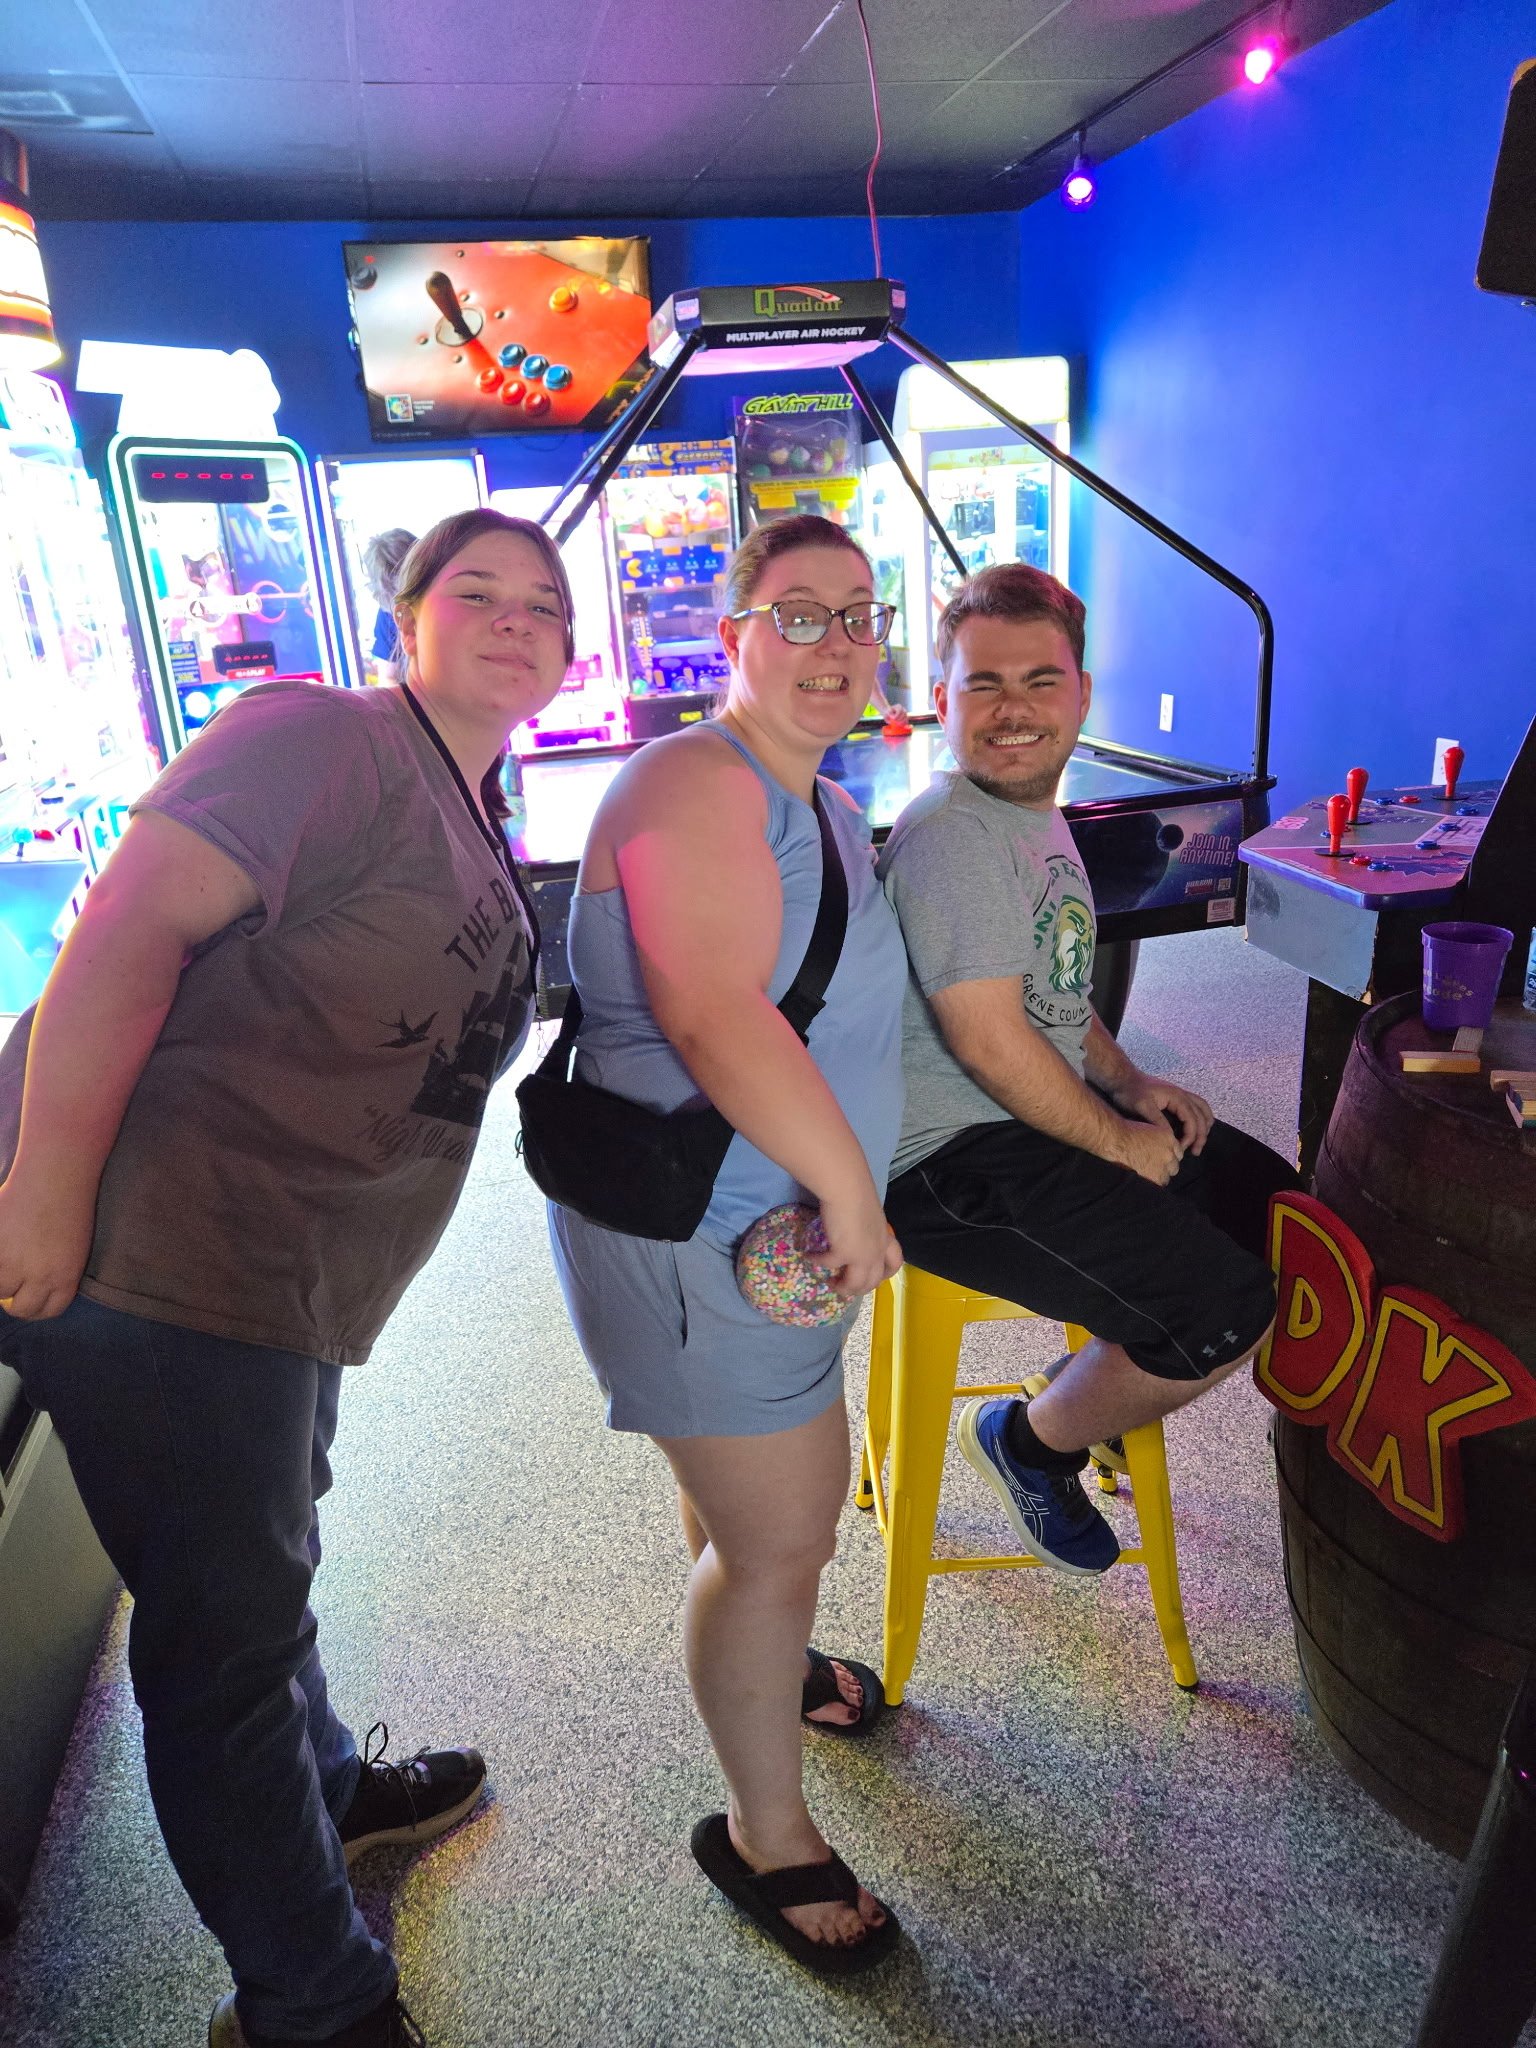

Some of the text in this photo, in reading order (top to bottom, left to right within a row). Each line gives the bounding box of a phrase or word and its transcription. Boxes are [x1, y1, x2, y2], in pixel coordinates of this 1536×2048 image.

[726, 326, 867, 343] MULTIPLAYER AIR HOCKEY
[814, 393, 854, 411] HILL
[1187, 833, 1231, 850] JOIN IN
[1180, 848, 1236, 867] ANYTIME!
[443, 896, 500, 974] THE
[1256, 1202, 1513, 1529] DK
